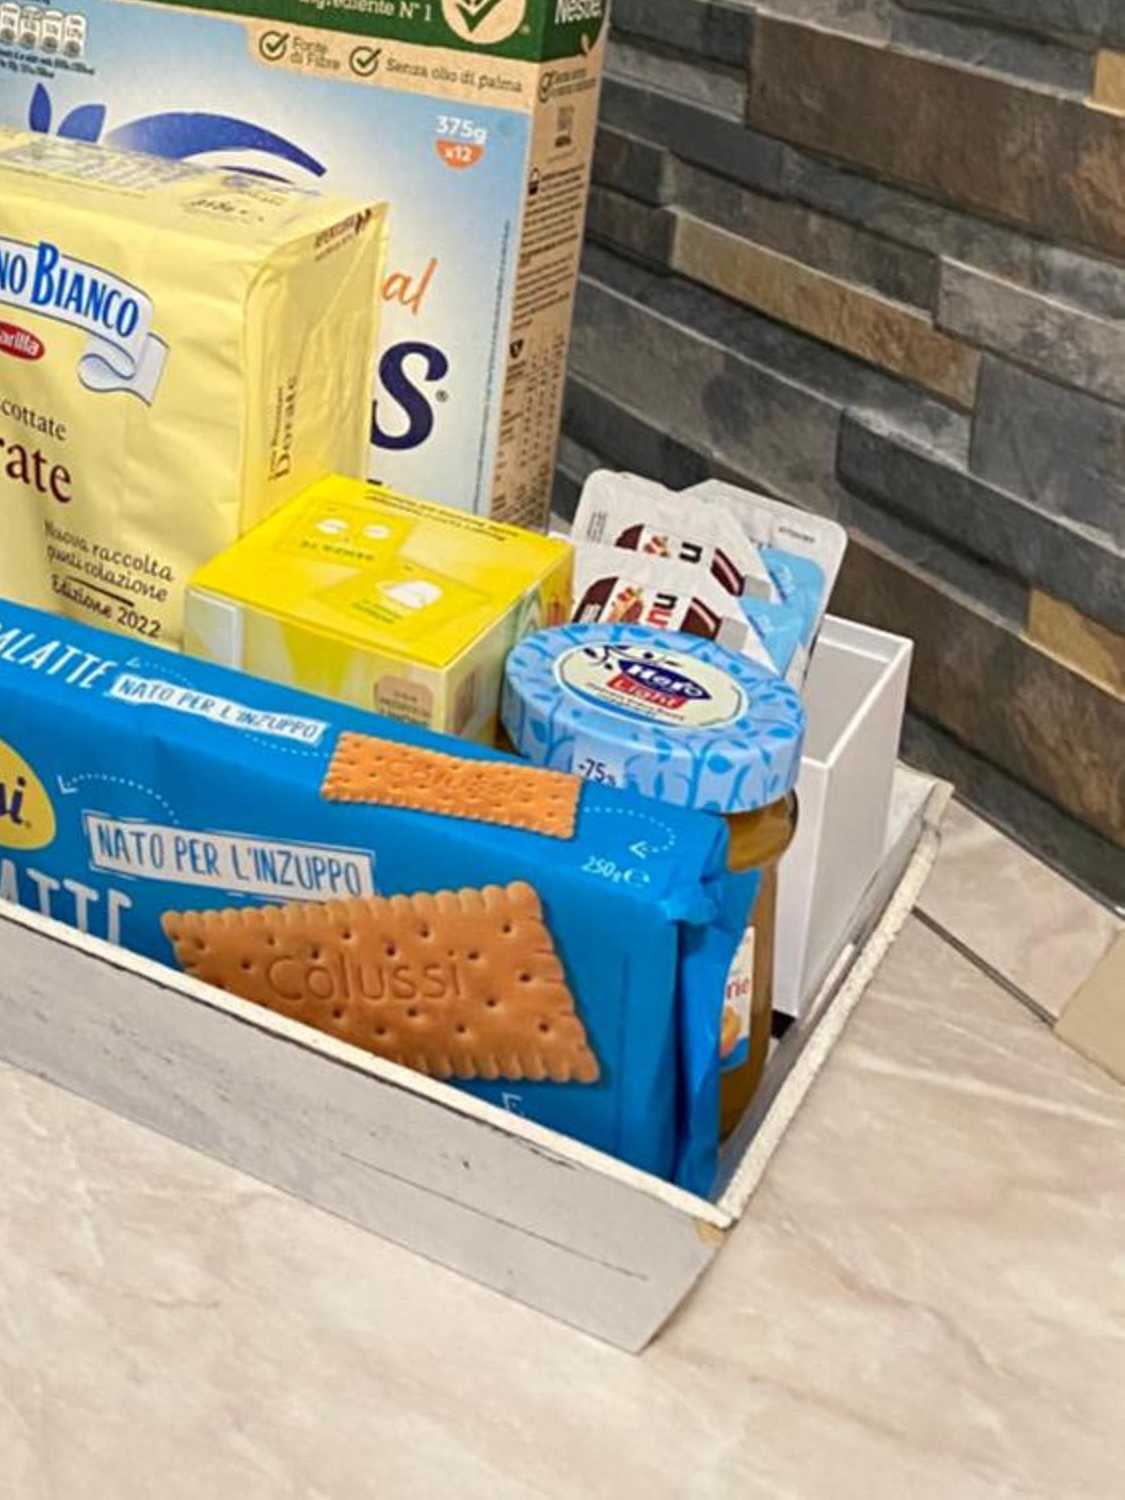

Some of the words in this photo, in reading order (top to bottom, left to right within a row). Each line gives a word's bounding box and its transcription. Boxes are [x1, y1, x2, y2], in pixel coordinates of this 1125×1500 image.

[424, 4, 432, 22] 1
[290, 49, 307, 66] di
[310, 53, 341, 72] Fibre
[385, 57, 428, 79] Senza
[431, 65, 458, 84] olio
[460, 69, 476, 87] di
[478, 74, 524, 94] palma
[435, 115, 488, 144] 375g
[92, 544, 175, 582] raccolta
[84, 561, 168, 603] colazione
[117, 605, 161, 639] 2022
[119, 677, 176, 702] NATO
[177, 690, 215, 713] PER
[96, 823, 165, 869] NATO
[175, 835, 220, 876] PER
[231, 844, 363, 898] L'INZUPPO
[266, 951, 463, 1002] Colussi
